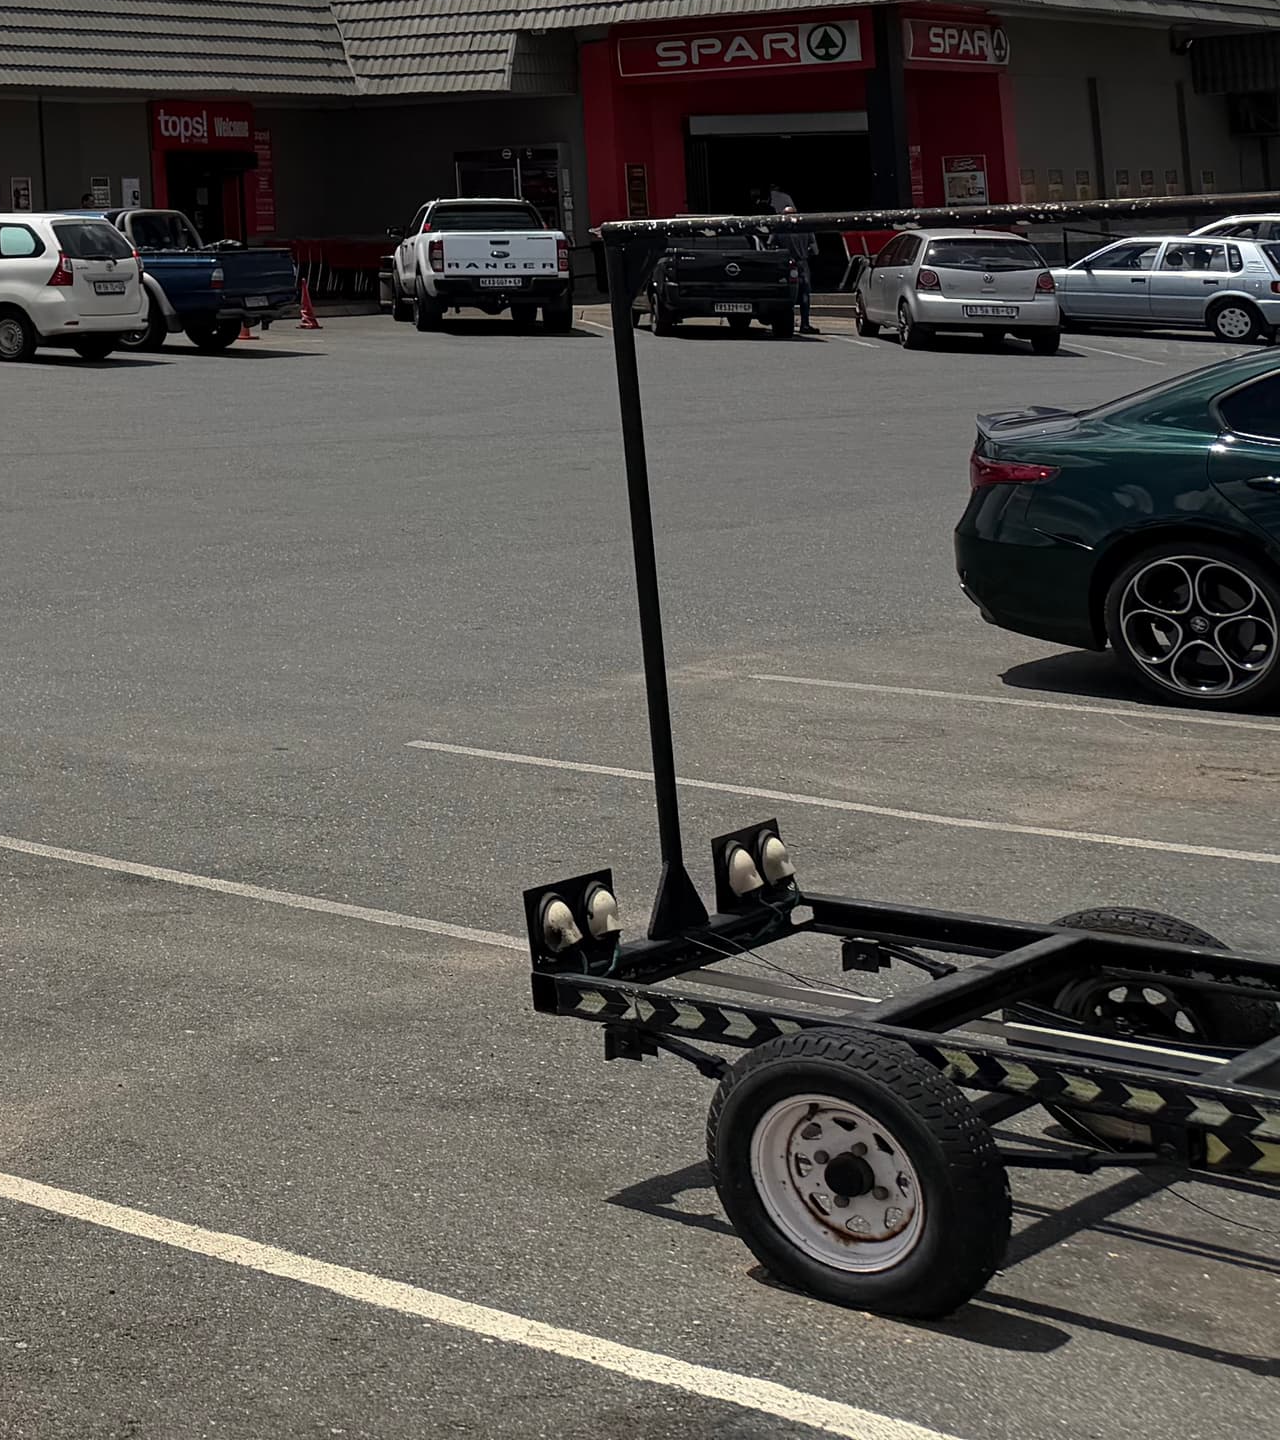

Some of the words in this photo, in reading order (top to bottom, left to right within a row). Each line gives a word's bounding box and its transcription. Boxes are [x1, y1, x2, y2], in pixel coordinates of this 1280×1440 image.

[656, 32, 800, 68] SPAR
[928, 26, 988, 55] SPAR
[157, 109, 208, 143] tops!
[214, 116, 249, 137] Welcome
[448, 262, 554, 270] RANGER
